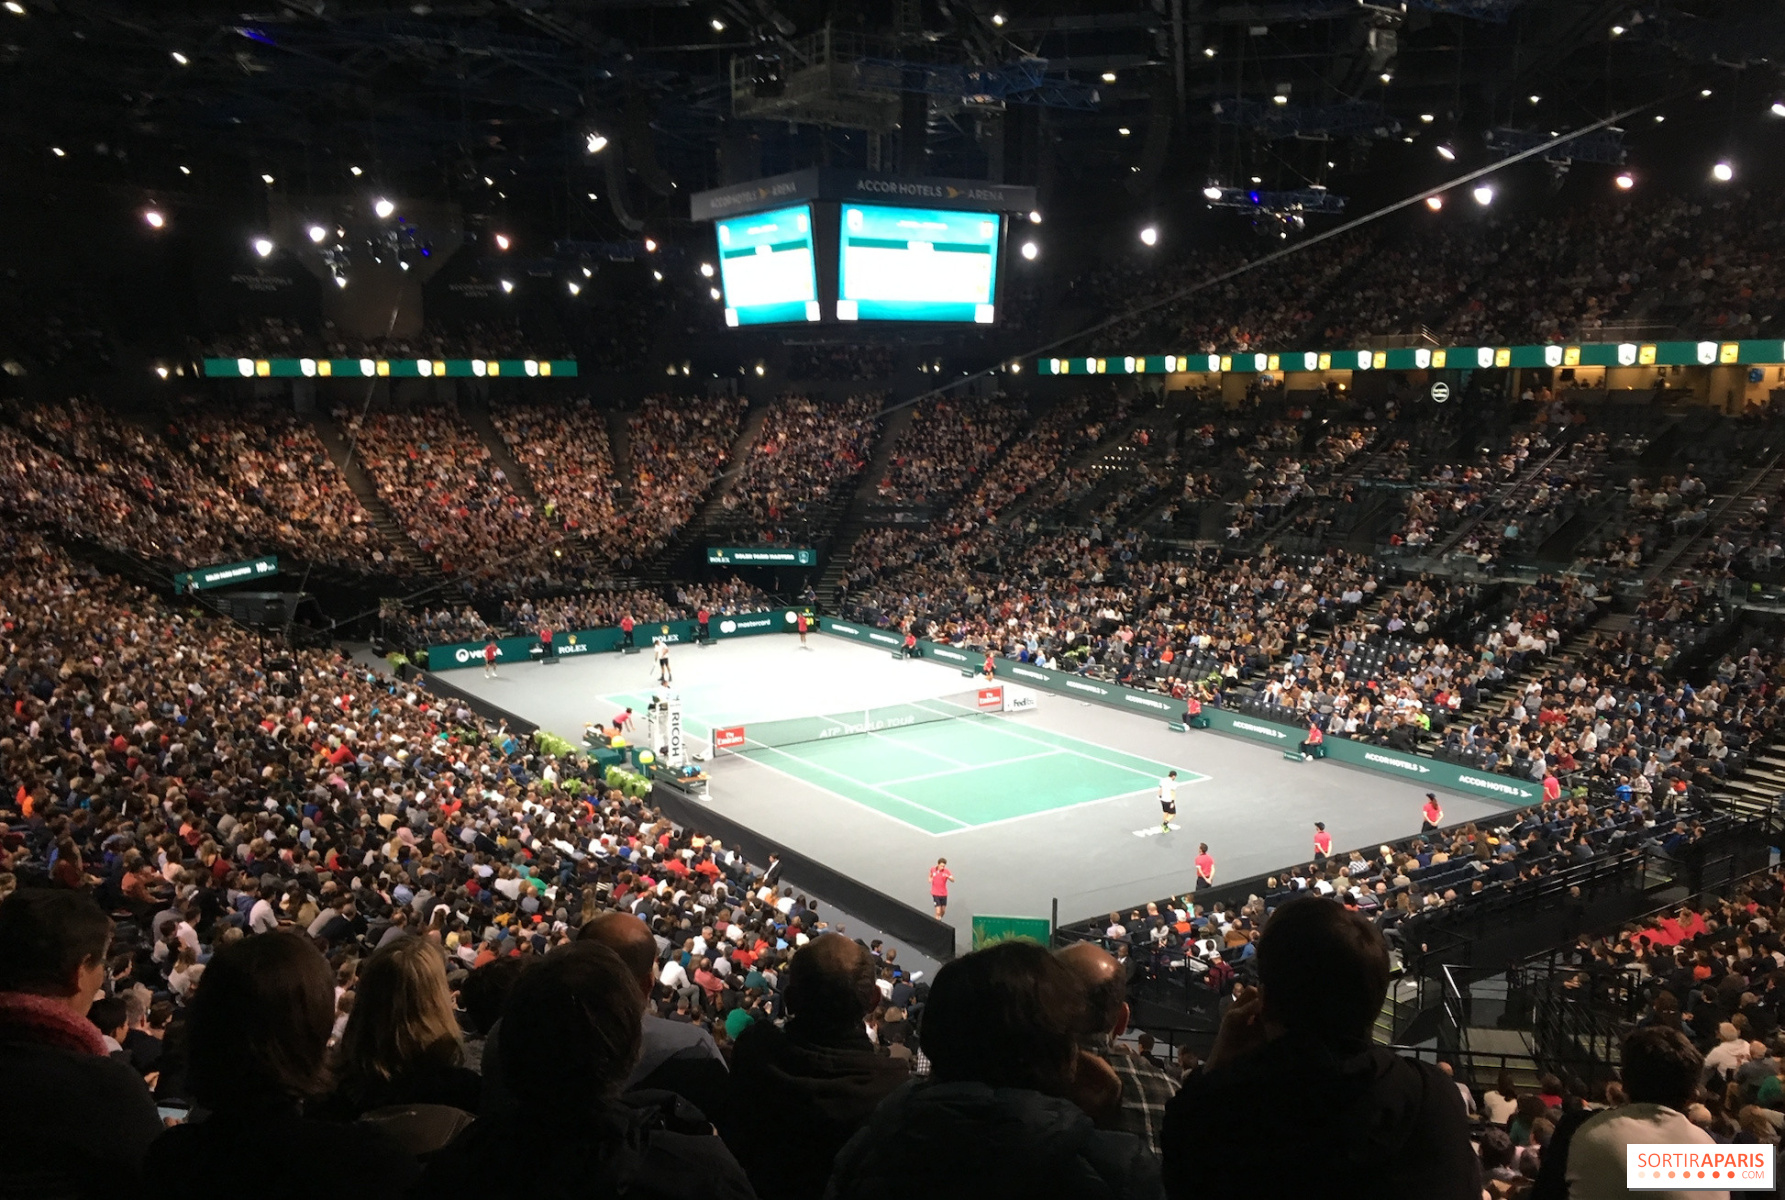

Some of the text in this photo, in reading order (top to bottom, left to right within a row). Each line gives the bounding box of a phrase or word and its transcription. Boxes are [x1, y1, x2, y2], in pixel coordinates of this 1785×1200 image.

[968, 188, 1005, 202] ARENA
[558, 644, 588, 654] ROLEX
[671, 712, 680, 757] RICOH
[818, 726, 841, 739] ATP
[887, 715, 915, 727] TOUR
